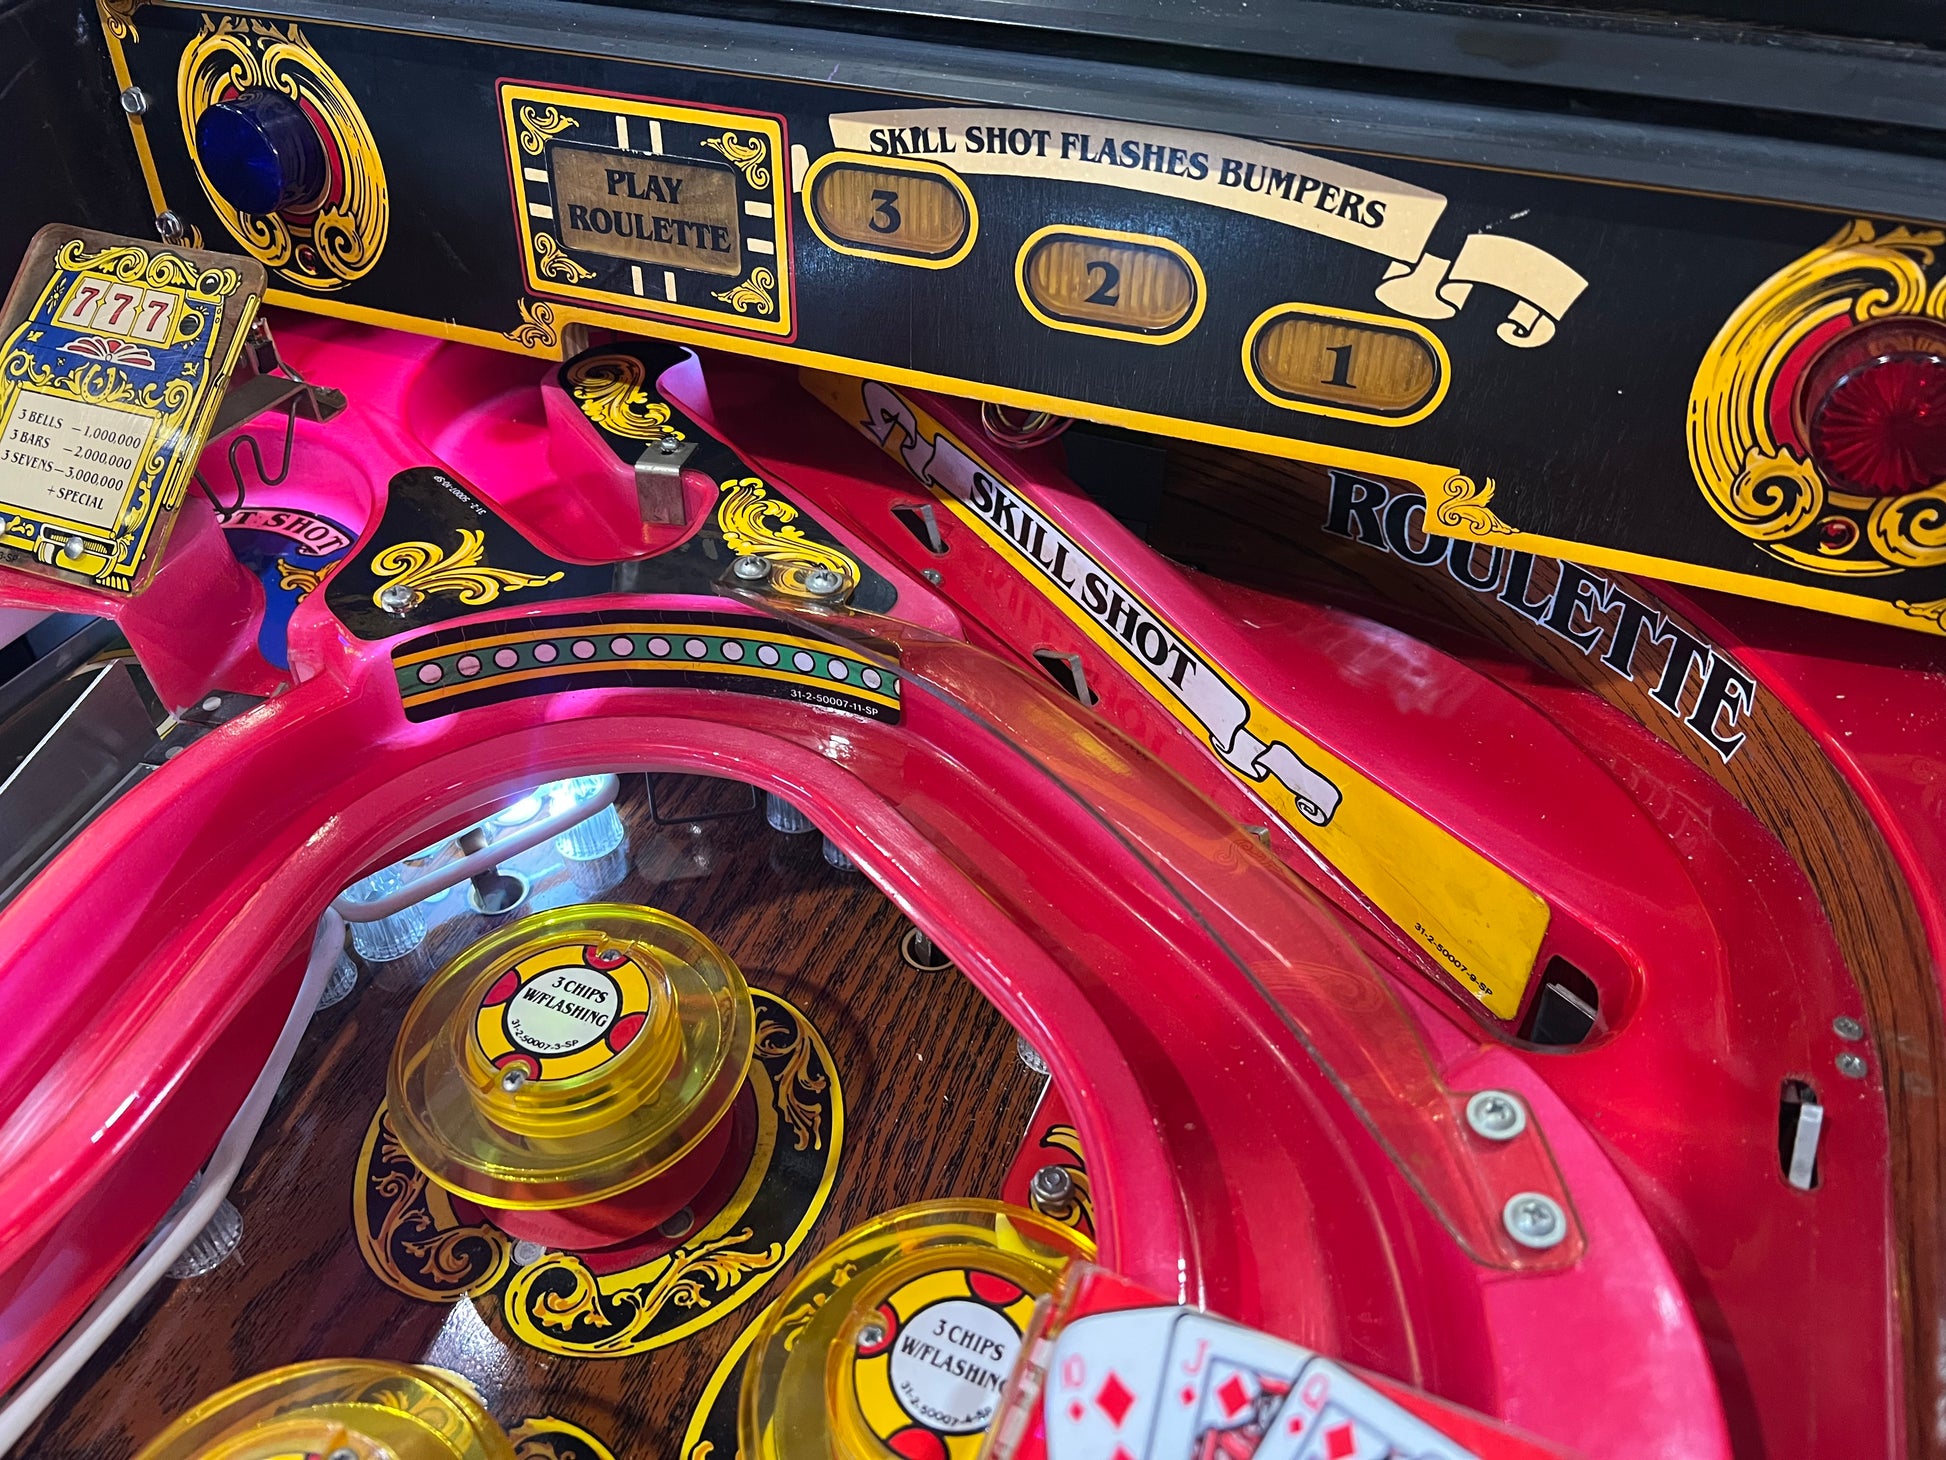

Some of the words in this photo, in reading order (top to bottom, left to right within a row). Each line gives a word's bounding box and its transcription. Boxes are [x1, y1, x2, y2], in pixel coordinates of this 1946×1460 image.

[605, 168, 683, 205] PLAY
[870, 126, 956, 156] SKILL
[964, 126, 1051, 158] SHOT
[1061, 131, 1209, 181] FLASHES
[1217, 158, 1387, 229] BUMPERS
[567, 203, 732, 254] ROULETTE
[868, 189, 902, 234] 3
[1084, 261, 1120, 306] 2
[73, 287, 99, 317] 7
[109, 293, 133, 325] 7
[145, 301, 168, 331] 7
[1320, 344, 1357, 389] 1
[18, 408, 27, 420] 3
[28, 411, 63, 429] BELLS
[10, 429, 19, 440] 3
[20, 432, 51, 448] BARS
[1, 449, 10, 461] 3
[11, 452, 54, 473] SEVENS
[57, 487, 104, 510] SPECIAL
[263, 513, 343, 552] SHOT
[969, 470, 1077, 588] SKILL
[1081, 575, 1197, 692] SHOT
[1322, 469, 1757, 764] ROULETTE
[790, 688, 879, 716] 31-2-50007-11-SP
[1414, 922, 1493, 996] 31-2-50007-9-SP
[522, 987, 609, 1027] W/FLASHING
[552, 976, 565, 988] 3
[564, 980, 609, 1004] CHIPS
[511, 1018, 579, 1050] 31-2-50007-3-SP
[933, 1319, 946, 1336] 3
[948, 1325, 1006, 1361] CHIPS
[1184, 1339, 1210, 1374] J
[1302, 1373, 1330, 1411] Q
